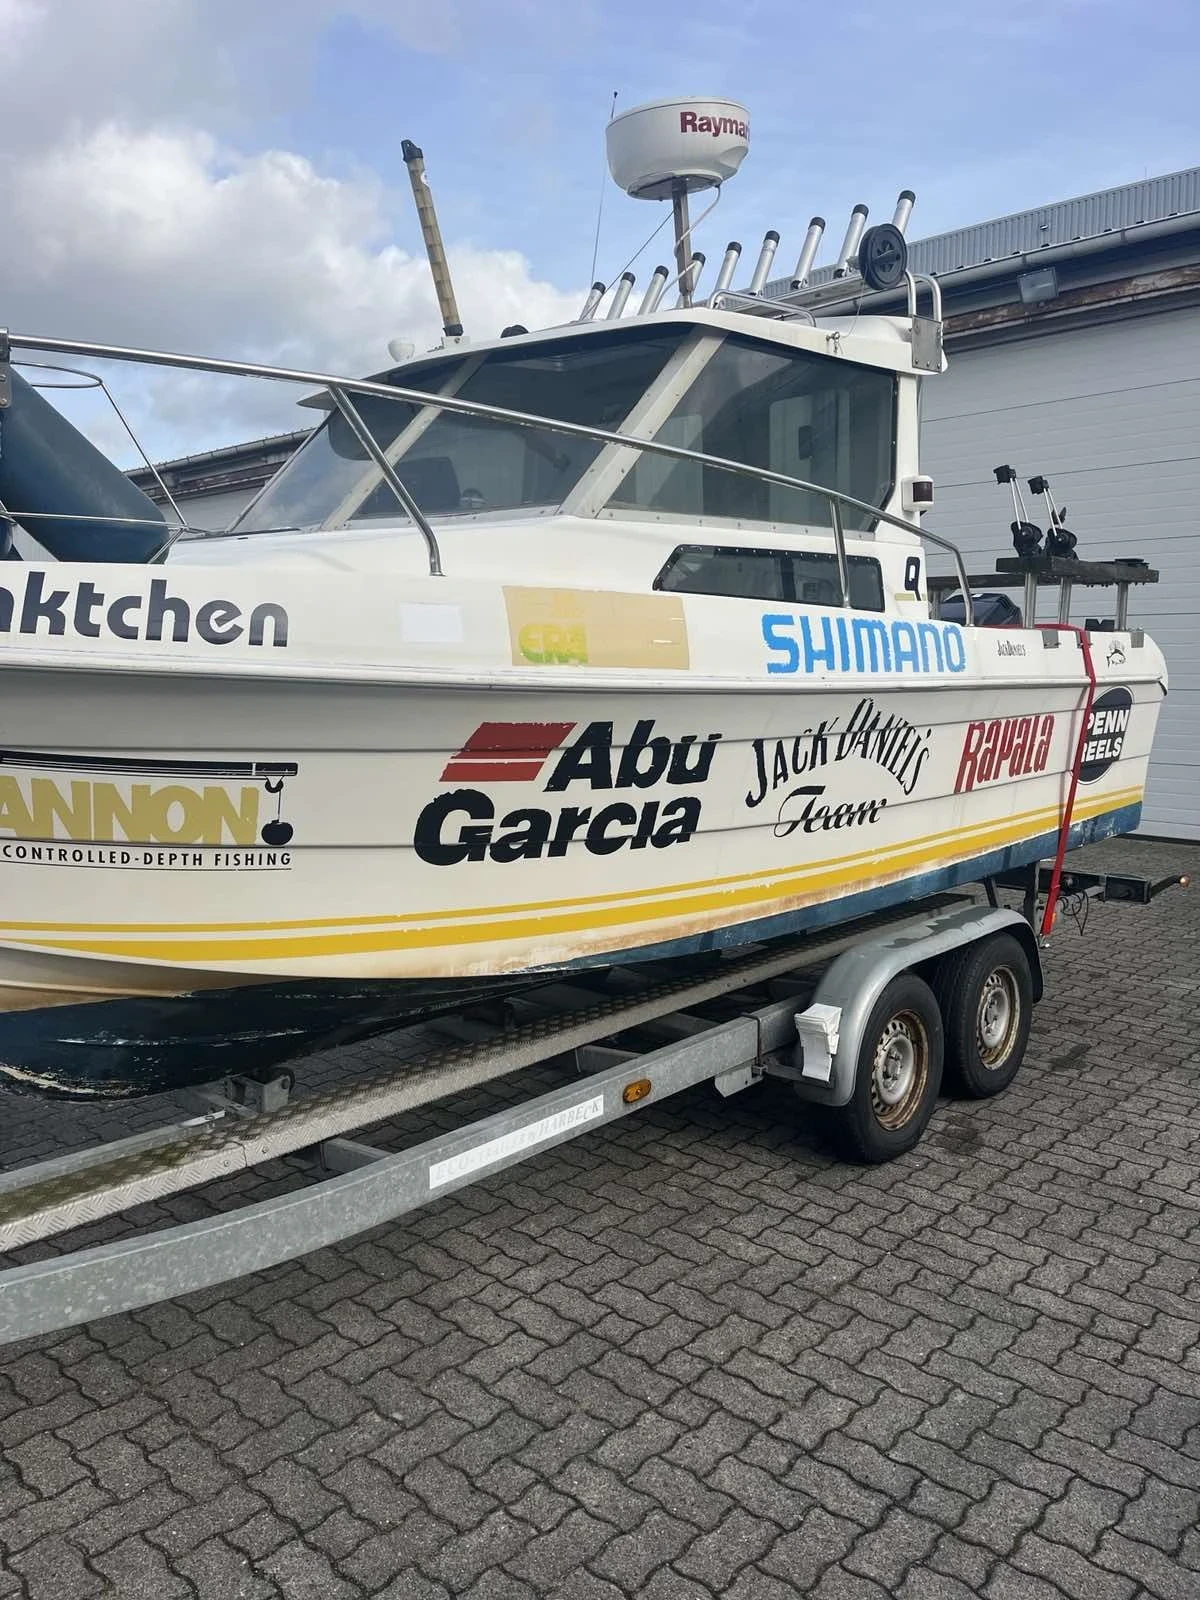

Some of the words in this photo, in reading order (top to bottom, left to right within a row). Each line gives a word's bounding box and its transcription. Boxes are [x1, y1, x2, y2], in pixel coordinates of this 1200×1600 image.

[680, 111, 750, 141] Rayma
[761, 613, 966, 673] SHIMANO
[542, 719, 722, 792] Abu
[746, 716, 840, 808] JACK
[413, 788, 702, 866] Garcia
[774, 785, 887, 838] Team
[3, 845, 203, 866] CONTROLLED-DEPTH
[214, 853, 292, 867] FISHING
